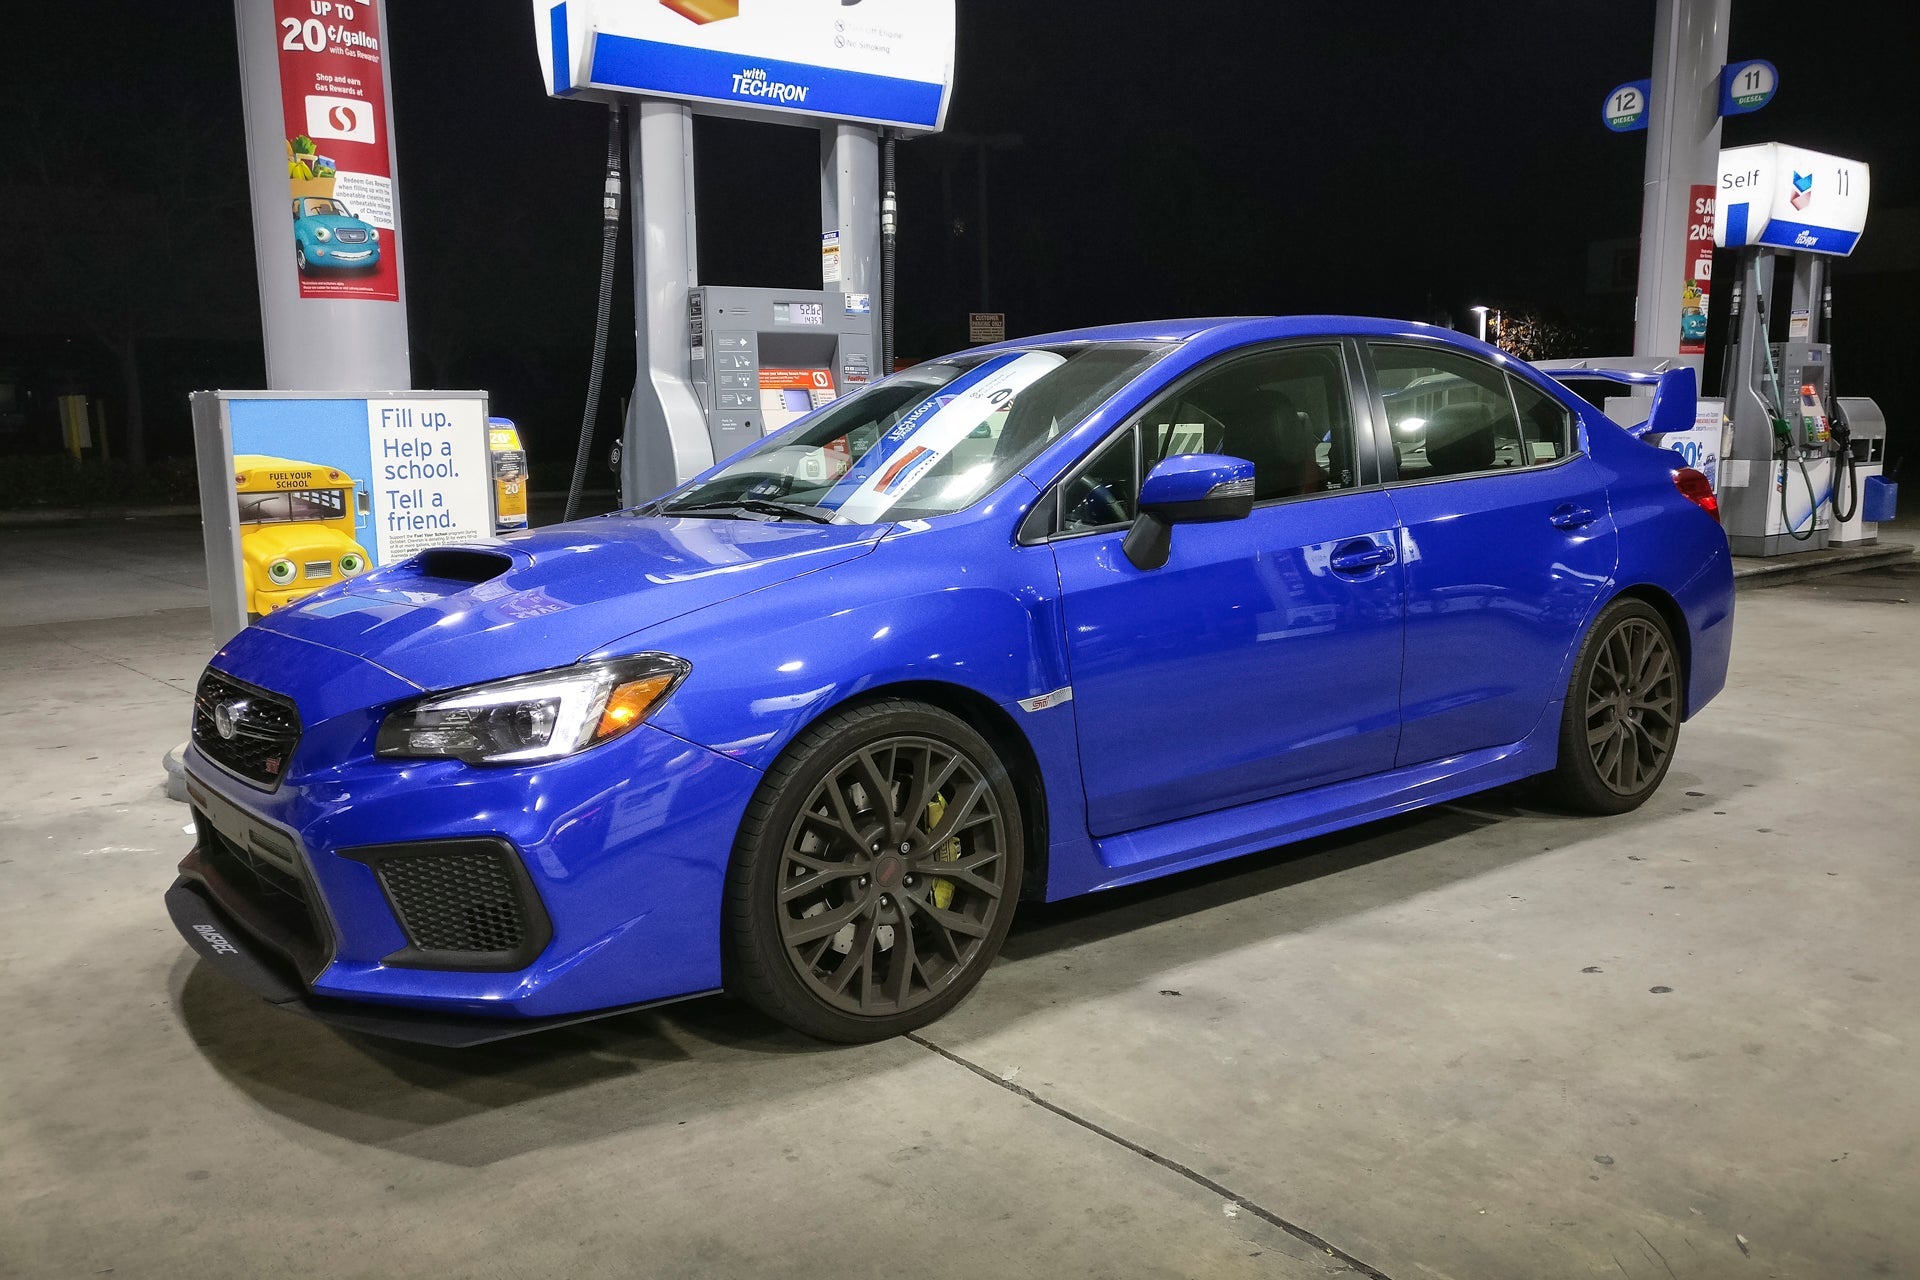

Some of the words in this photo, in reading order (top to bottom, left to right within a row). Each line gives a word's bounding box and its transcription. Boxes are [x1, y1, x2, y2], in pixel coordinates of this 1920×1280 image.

[311, 0, 332, 16] UP
[335, 4, 354, 20] TO
[330, 47, 344, 55] with
[345, 48, 356, 57] Gas
[316, 73, 333, 82] Shop
[742, 68, 766, 80] with
[1744, 70, 1760, 90] 11
[329, 85, 355, 95] Rewards
[732, 74, 807, 103] TECHRON
[1616, 92, 1636, 112] 12
[1739, 96, 1763, 105] DIESEL
[1613, 116, 1635, 125] DIESEL
[1722, 169, 1760, 189] Self
[1838, 168, 1849, 196] 11
[382, 408, 412, 428] Fill
[421, 412, 452, 431] up.
[384, 438, 432, 461] Help
[441, 442, 451, 456] a
[385, 459, 458, 480] school.
[386, 489, 423, 509] Tell
[432, 493, 443, 507] a
[388, 509, 456, 531] friend.
